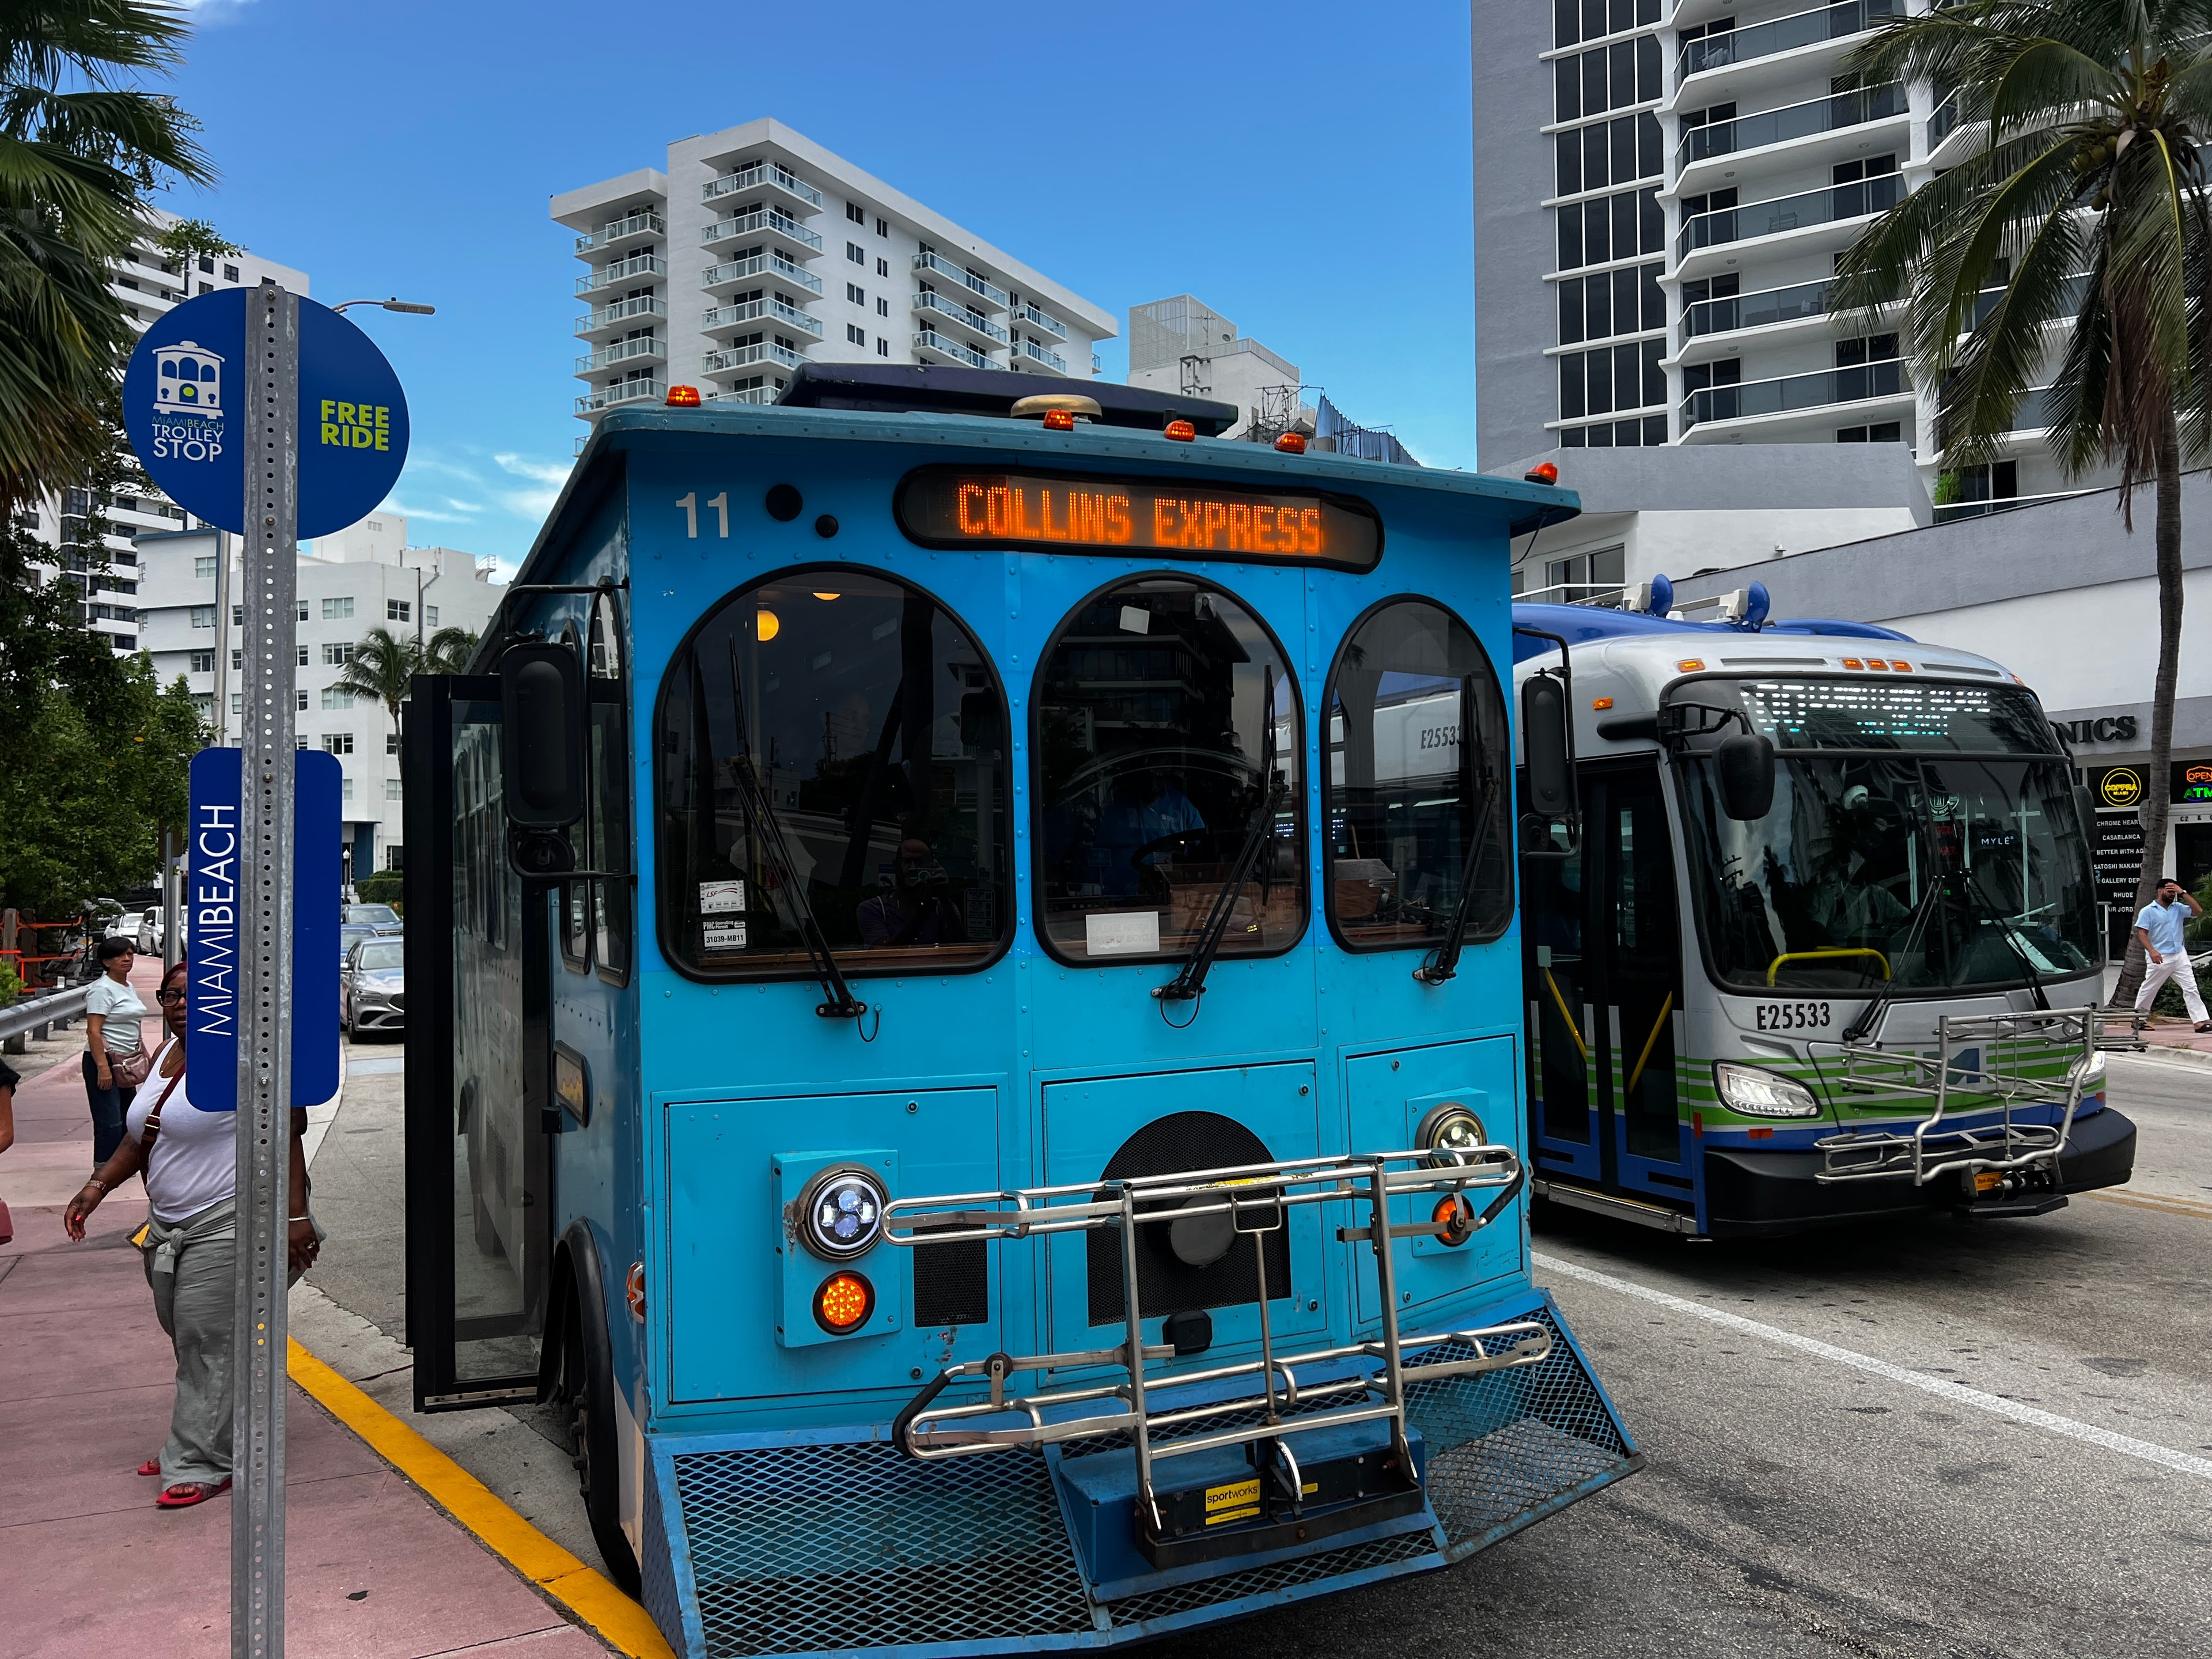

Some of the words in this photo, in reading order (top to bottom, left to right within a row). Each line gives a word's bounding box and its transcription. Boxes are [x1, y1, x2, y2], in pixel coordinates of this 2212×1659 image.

[151, 415, 224, 431] MIAMIBEACH
[321, 400, 389, 428] FREE
[152, 424, 224, 443] TROLLEY
[321, 423, 389, 451] RIDE
[153, 439, 223, 463] STOP
[676, 492, 729, 539] 11
[958, 484, 1131, 544] COLLINS
[1154, 497, 1320, 555] EXPRESS
[2183, 787, 2212, 798] ATM
[197, 805, 235, 1036] MIAMIBEACH
[703, 922, 715, 930] PMC
[706, 934, 744, 943] 31039-MB11
[1756, 1002, 1831, 1030] E25533
[1206, 1485, 1258, 1505] sportworks
